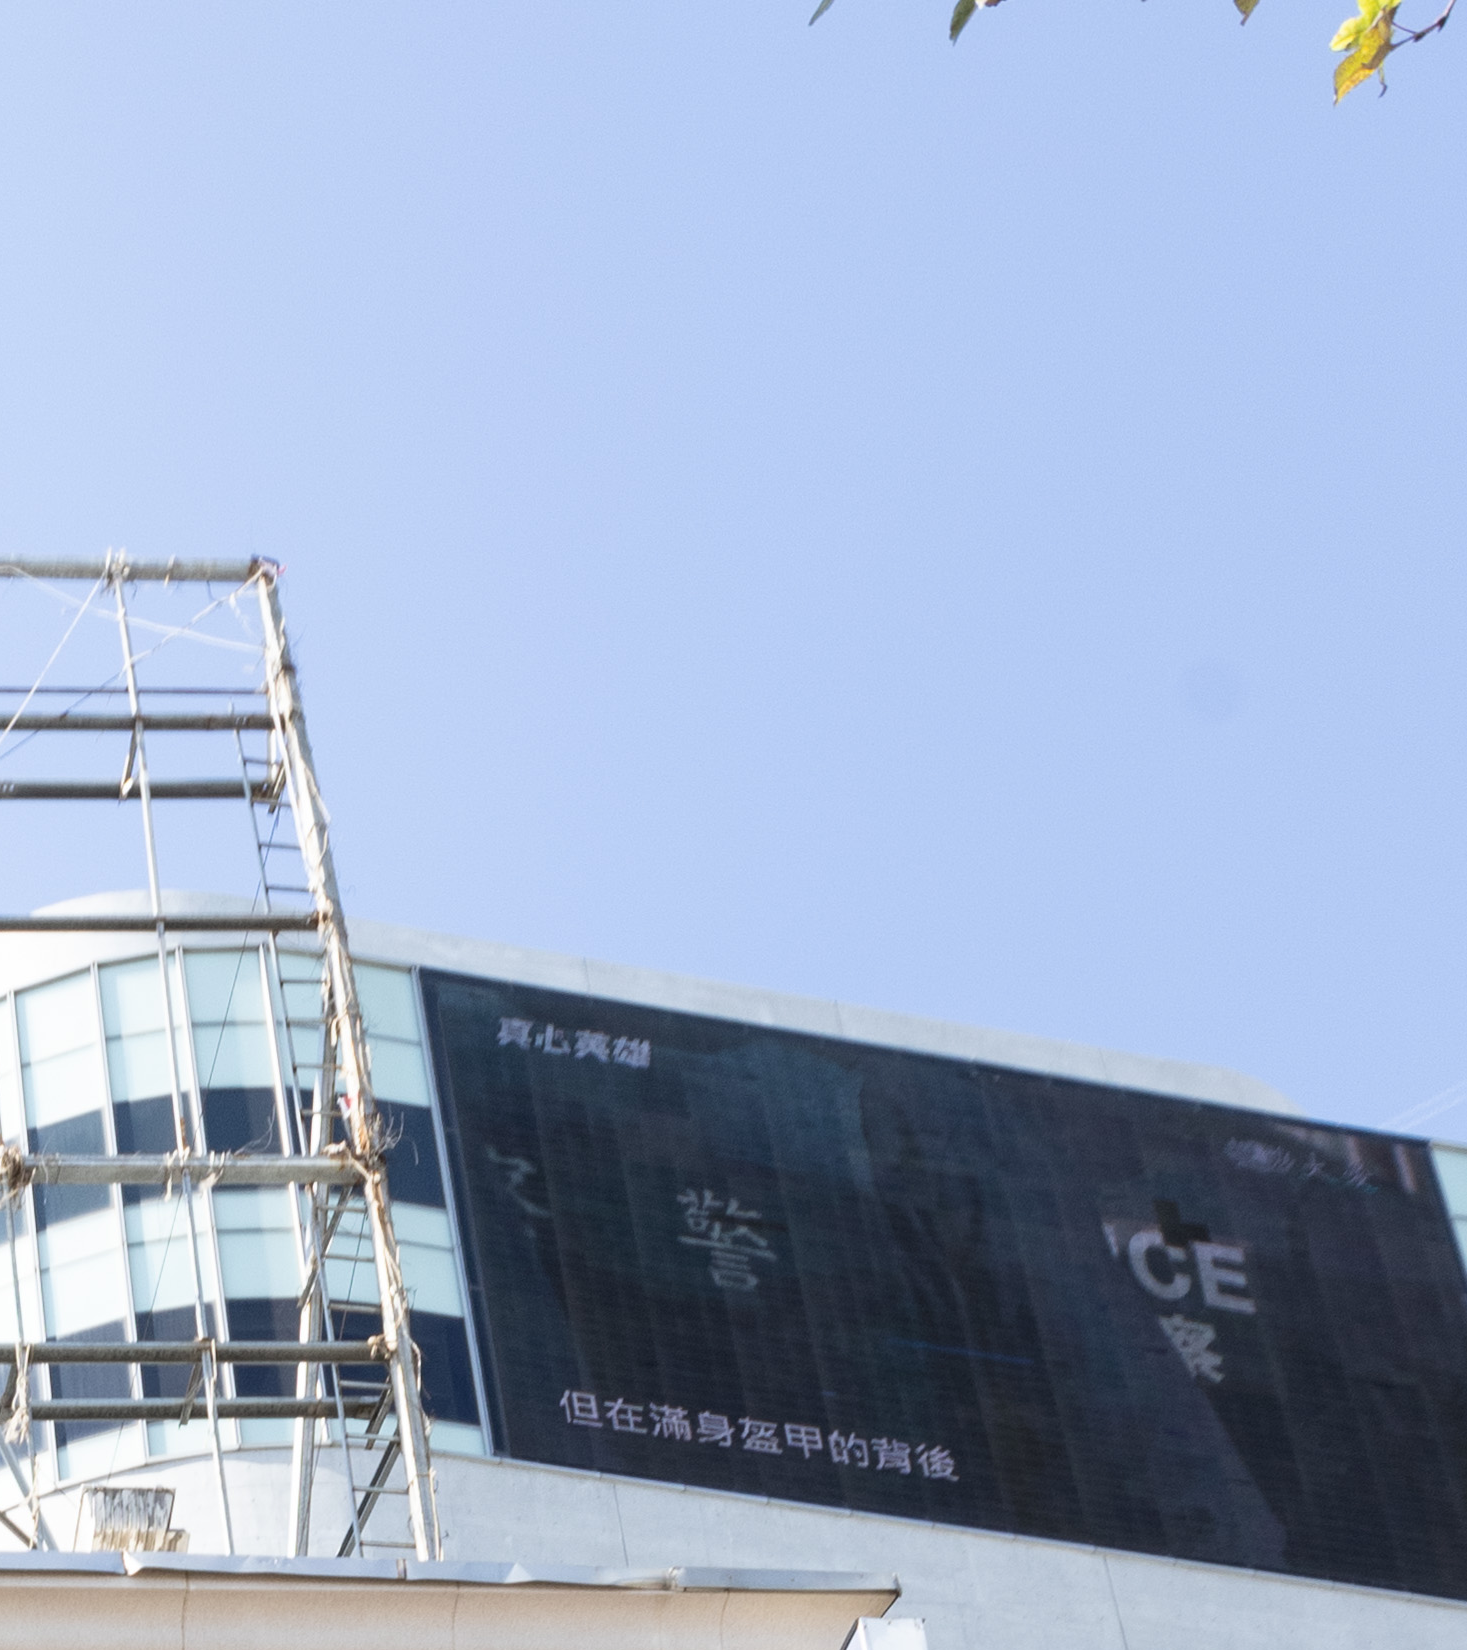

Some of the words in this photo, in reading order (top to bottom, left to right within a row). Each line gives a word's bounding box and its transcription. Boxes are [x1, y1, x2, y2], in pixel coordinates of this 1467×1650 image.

[1102, 1222, 1257, 1315] CE
[559, 1389, 960, 1482] 但在滿身盔甲的背後
